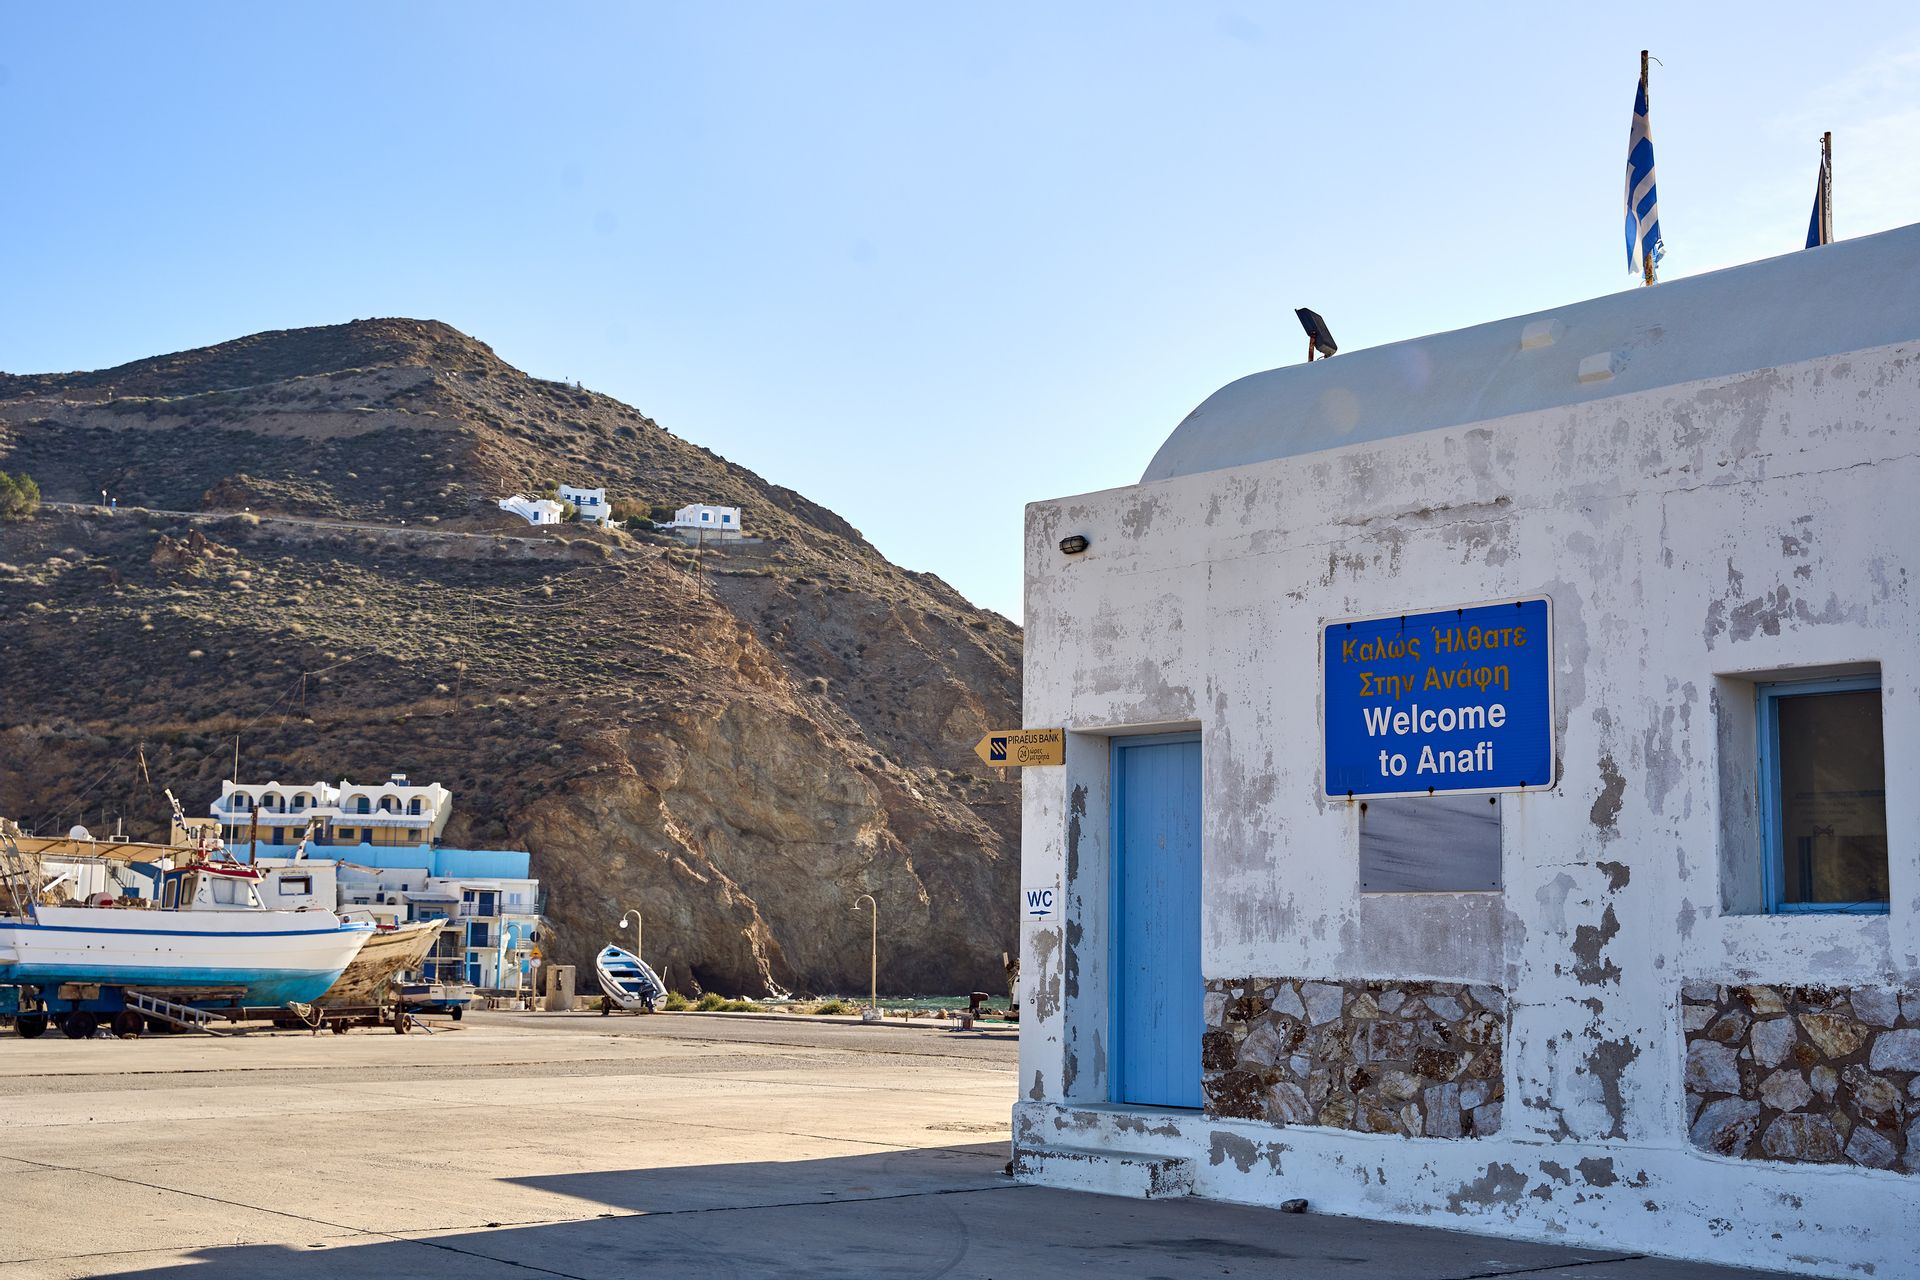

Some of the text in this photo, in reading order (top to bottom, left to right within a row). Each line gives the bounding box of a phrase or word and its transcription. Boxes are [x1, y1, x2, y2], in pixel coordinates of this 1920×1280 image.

[1342, 625, 1527, 663] Καλώς Ήλθατε
[1359, 661, 1510, 700] Στην Ανάφη
[1363, 703, 1507, 737] Welcome
[1008, 733, 1059, 744] PIRAEUS BANK
[1379, 741, 1494, 776] to Anafi
[1027, 890, 1052, 907] WC
